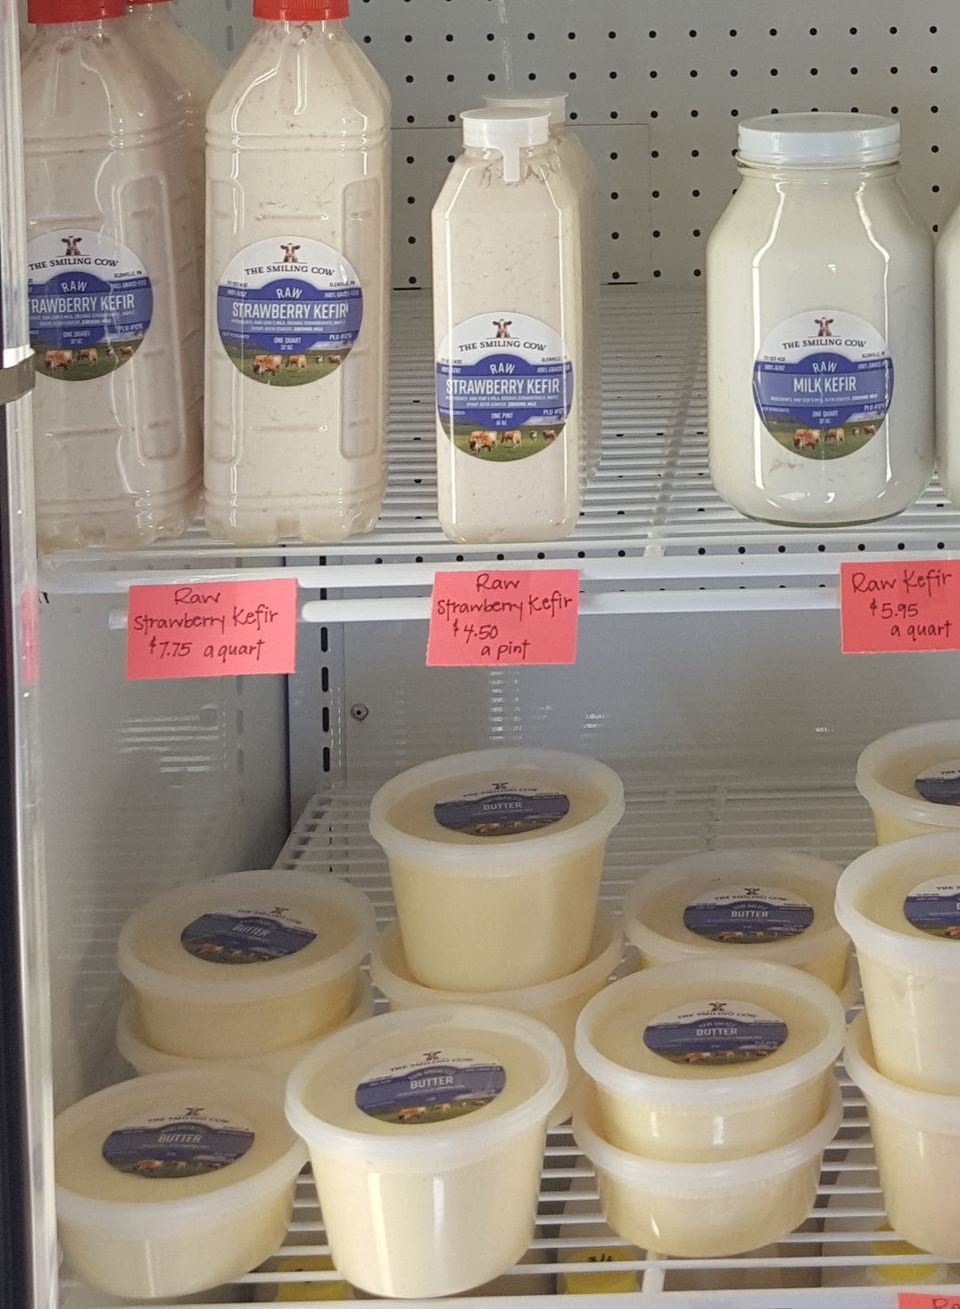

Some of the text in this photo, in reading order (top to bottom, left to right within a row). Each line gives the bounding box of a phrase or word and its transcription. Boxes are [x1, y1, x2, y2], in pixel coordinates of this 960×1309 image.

[311, 267, 335, 276] COW
[29, 294, 134, 313] RAWBERRY KEFIR
[233, 302, 346, 319] STRAWBERRY KEFIR
[446, 379, 559, 394] STRAWBERRY KEFIR
[794, 376, 856, 392] MILK KEFIR
[477, 574, 519, 592] Raw
[852, 570, 952, 596] Raw Kefir
[175, 587, 221, 604] Raw
[438, 599, 523, 621] Strawberry
[870, 598, 918, 618] $5.95
[135, 604, 278, 634] Strawberry Kefir
[453, 619, 498, 644] $4.50
[891, 621, 952, 641] a quart
[149, 636, 265, 662] $7.75 a quart
[481, 640, 530, 660] a pint
[483, 802, 522, 810] BUTTER
[731, 910, 769, 919] BUTTER
[697, 1028, 738, 1036] BUTTER
[410, 1076, 453, 1089] BUTTER
